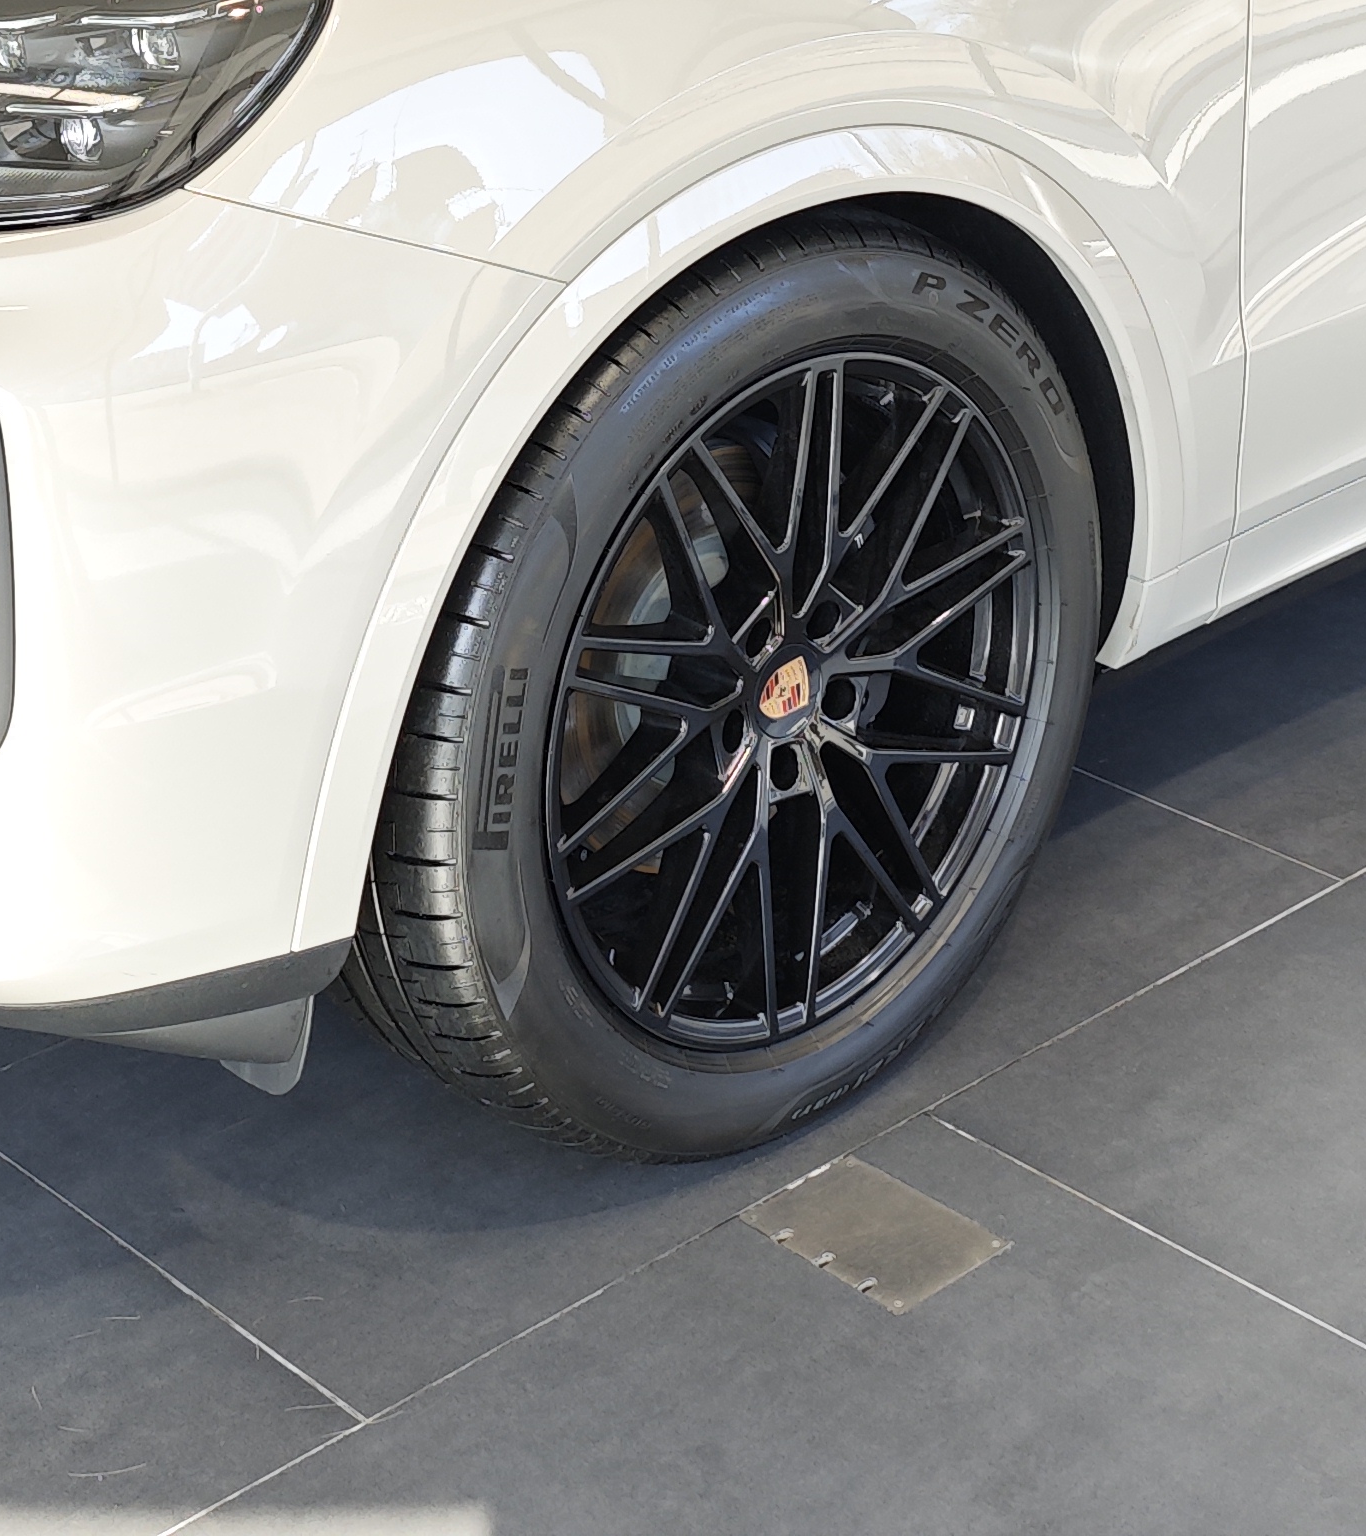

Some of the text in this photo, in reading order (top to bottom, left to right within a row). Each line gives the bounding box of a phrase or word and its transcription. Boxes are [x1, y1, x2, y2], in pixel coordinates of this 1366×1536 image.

[911, 271, 1066, 416] P ZERO
[472, 664, 529, 851] PIRELLI
